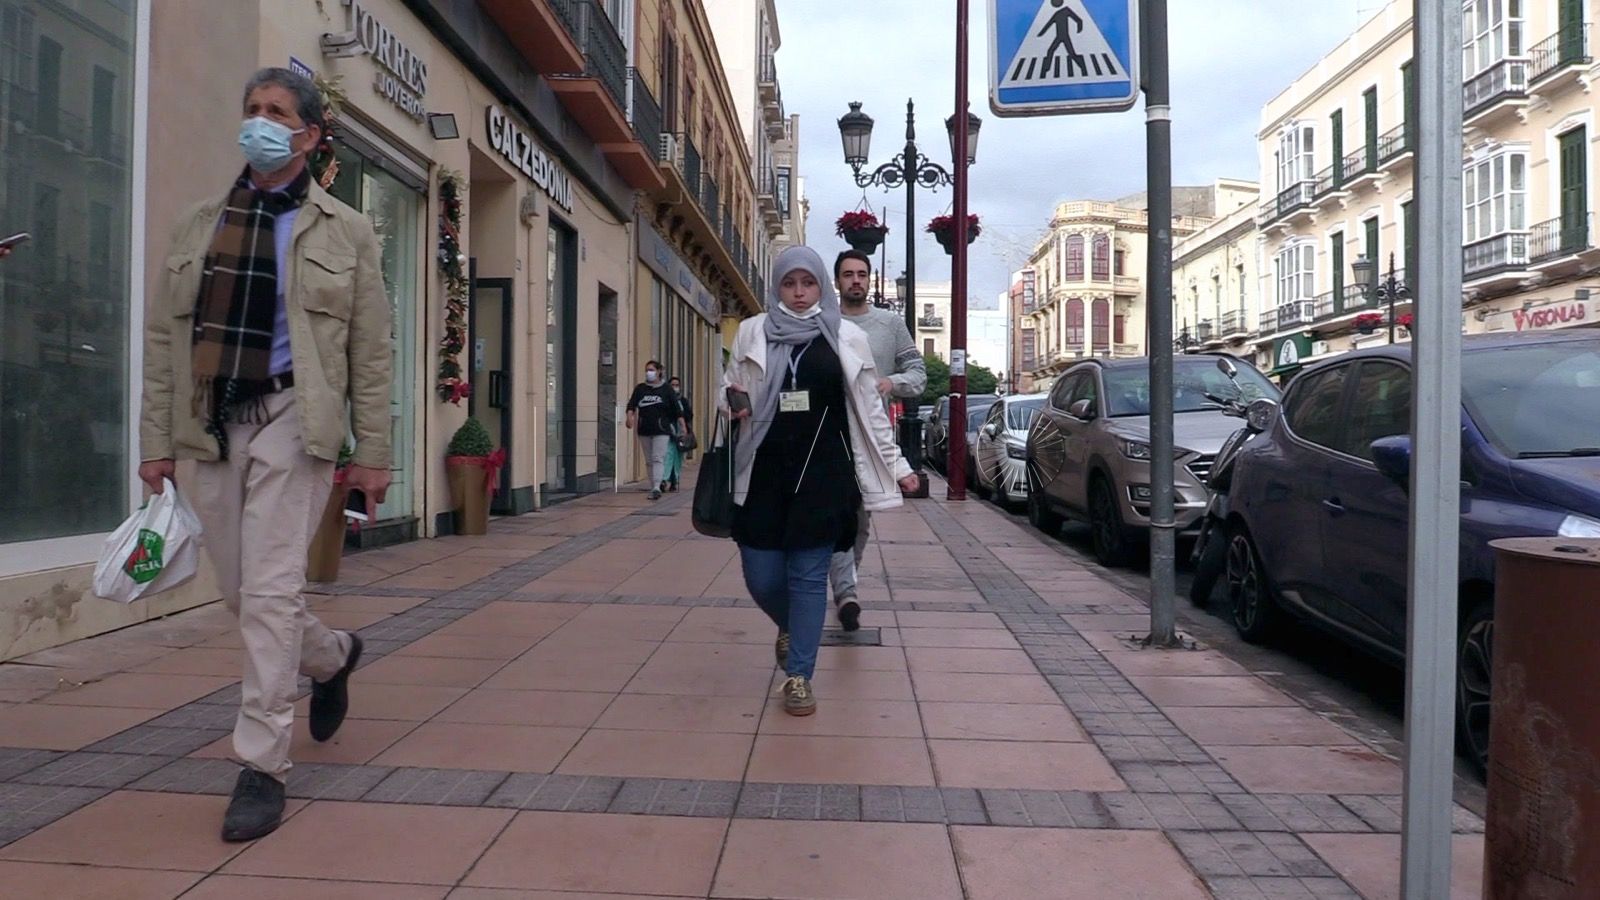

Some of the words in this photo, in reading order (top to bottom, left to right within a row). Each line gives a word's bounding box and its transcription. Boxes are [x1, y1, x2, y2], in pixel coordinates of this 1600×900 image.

[341, 0, 427, 97] TORRES
[375, 71, 426, 117] JOYEROS
[487, 104, 574, 213] CALZEDONIA
[1526, 303, 1585, 328] VISIONLAB
